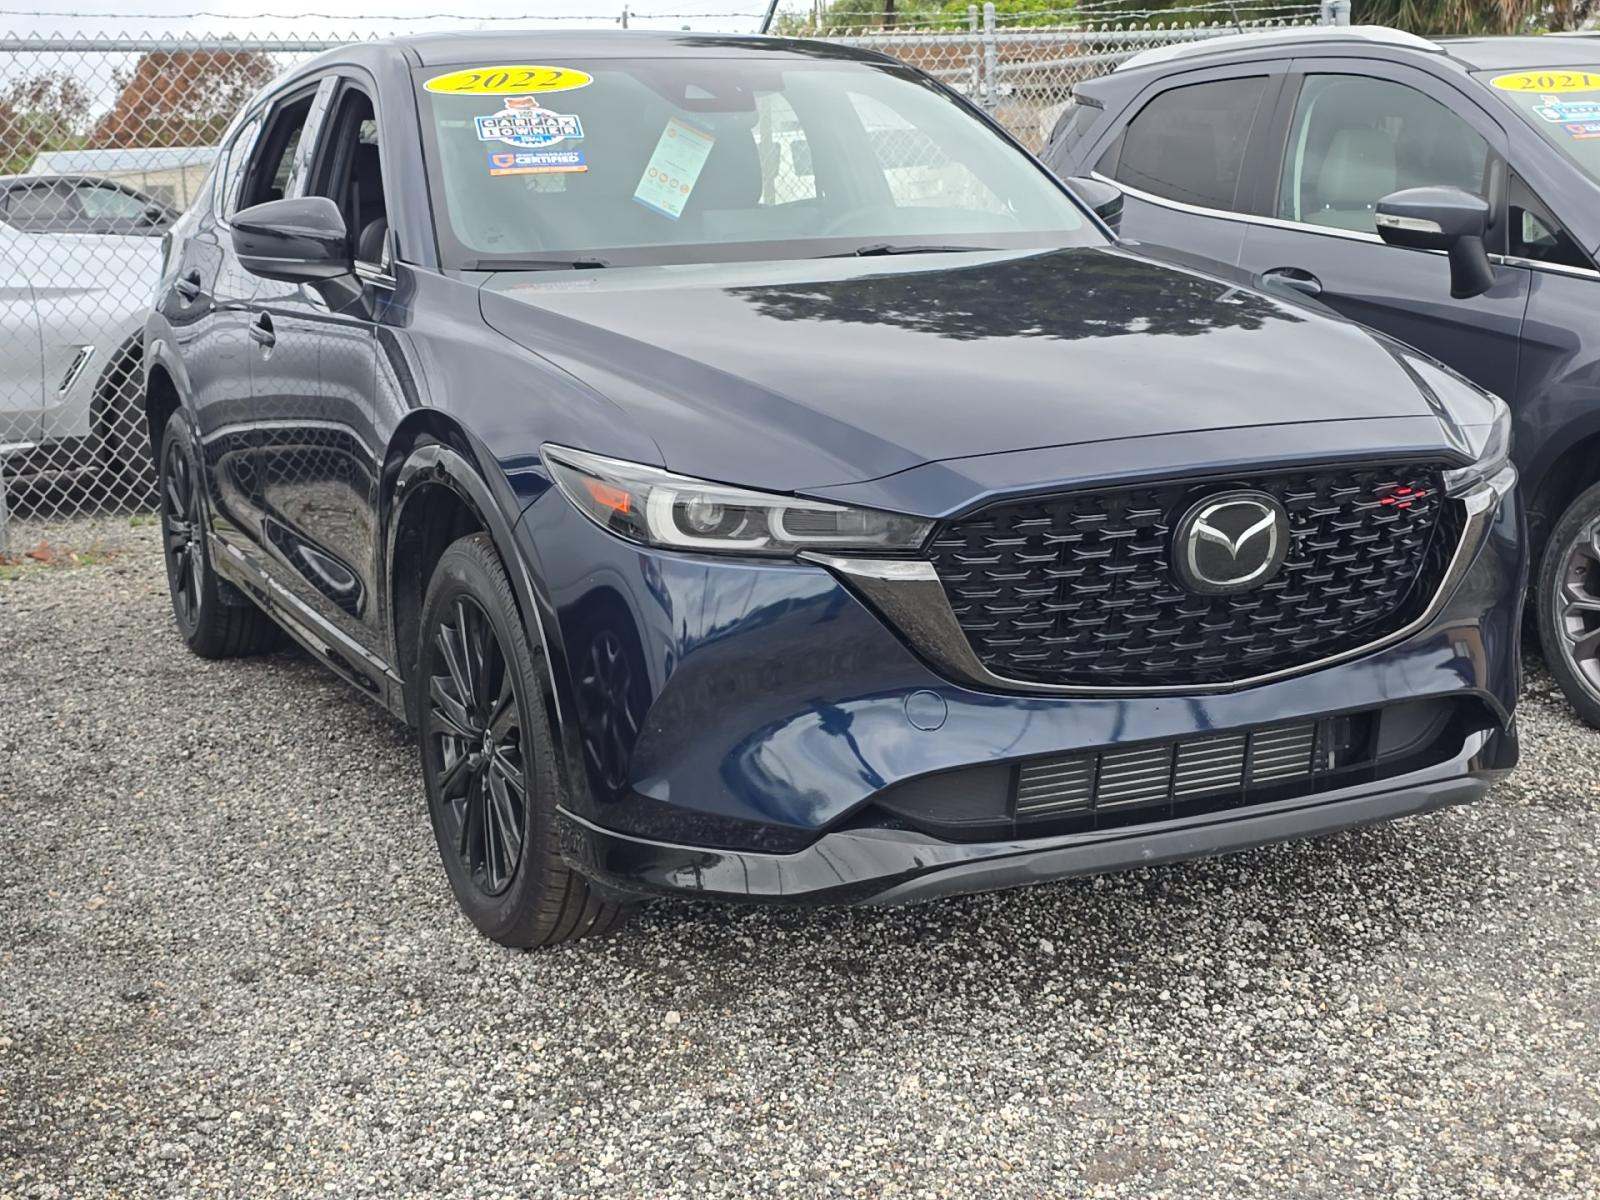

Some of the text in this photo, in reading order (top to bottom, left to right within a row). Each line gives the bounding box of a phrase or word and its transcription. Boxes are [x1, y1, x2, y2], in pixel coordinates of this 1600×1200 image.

[454, 70, 563, 91] 2022
[1518, 74, 1592, 90] 2021
[483, 118, 576, 127] CARFAX
[499, 126, 576, 136] OWNER
[515, 155, 579, 164] CERTIFIED
